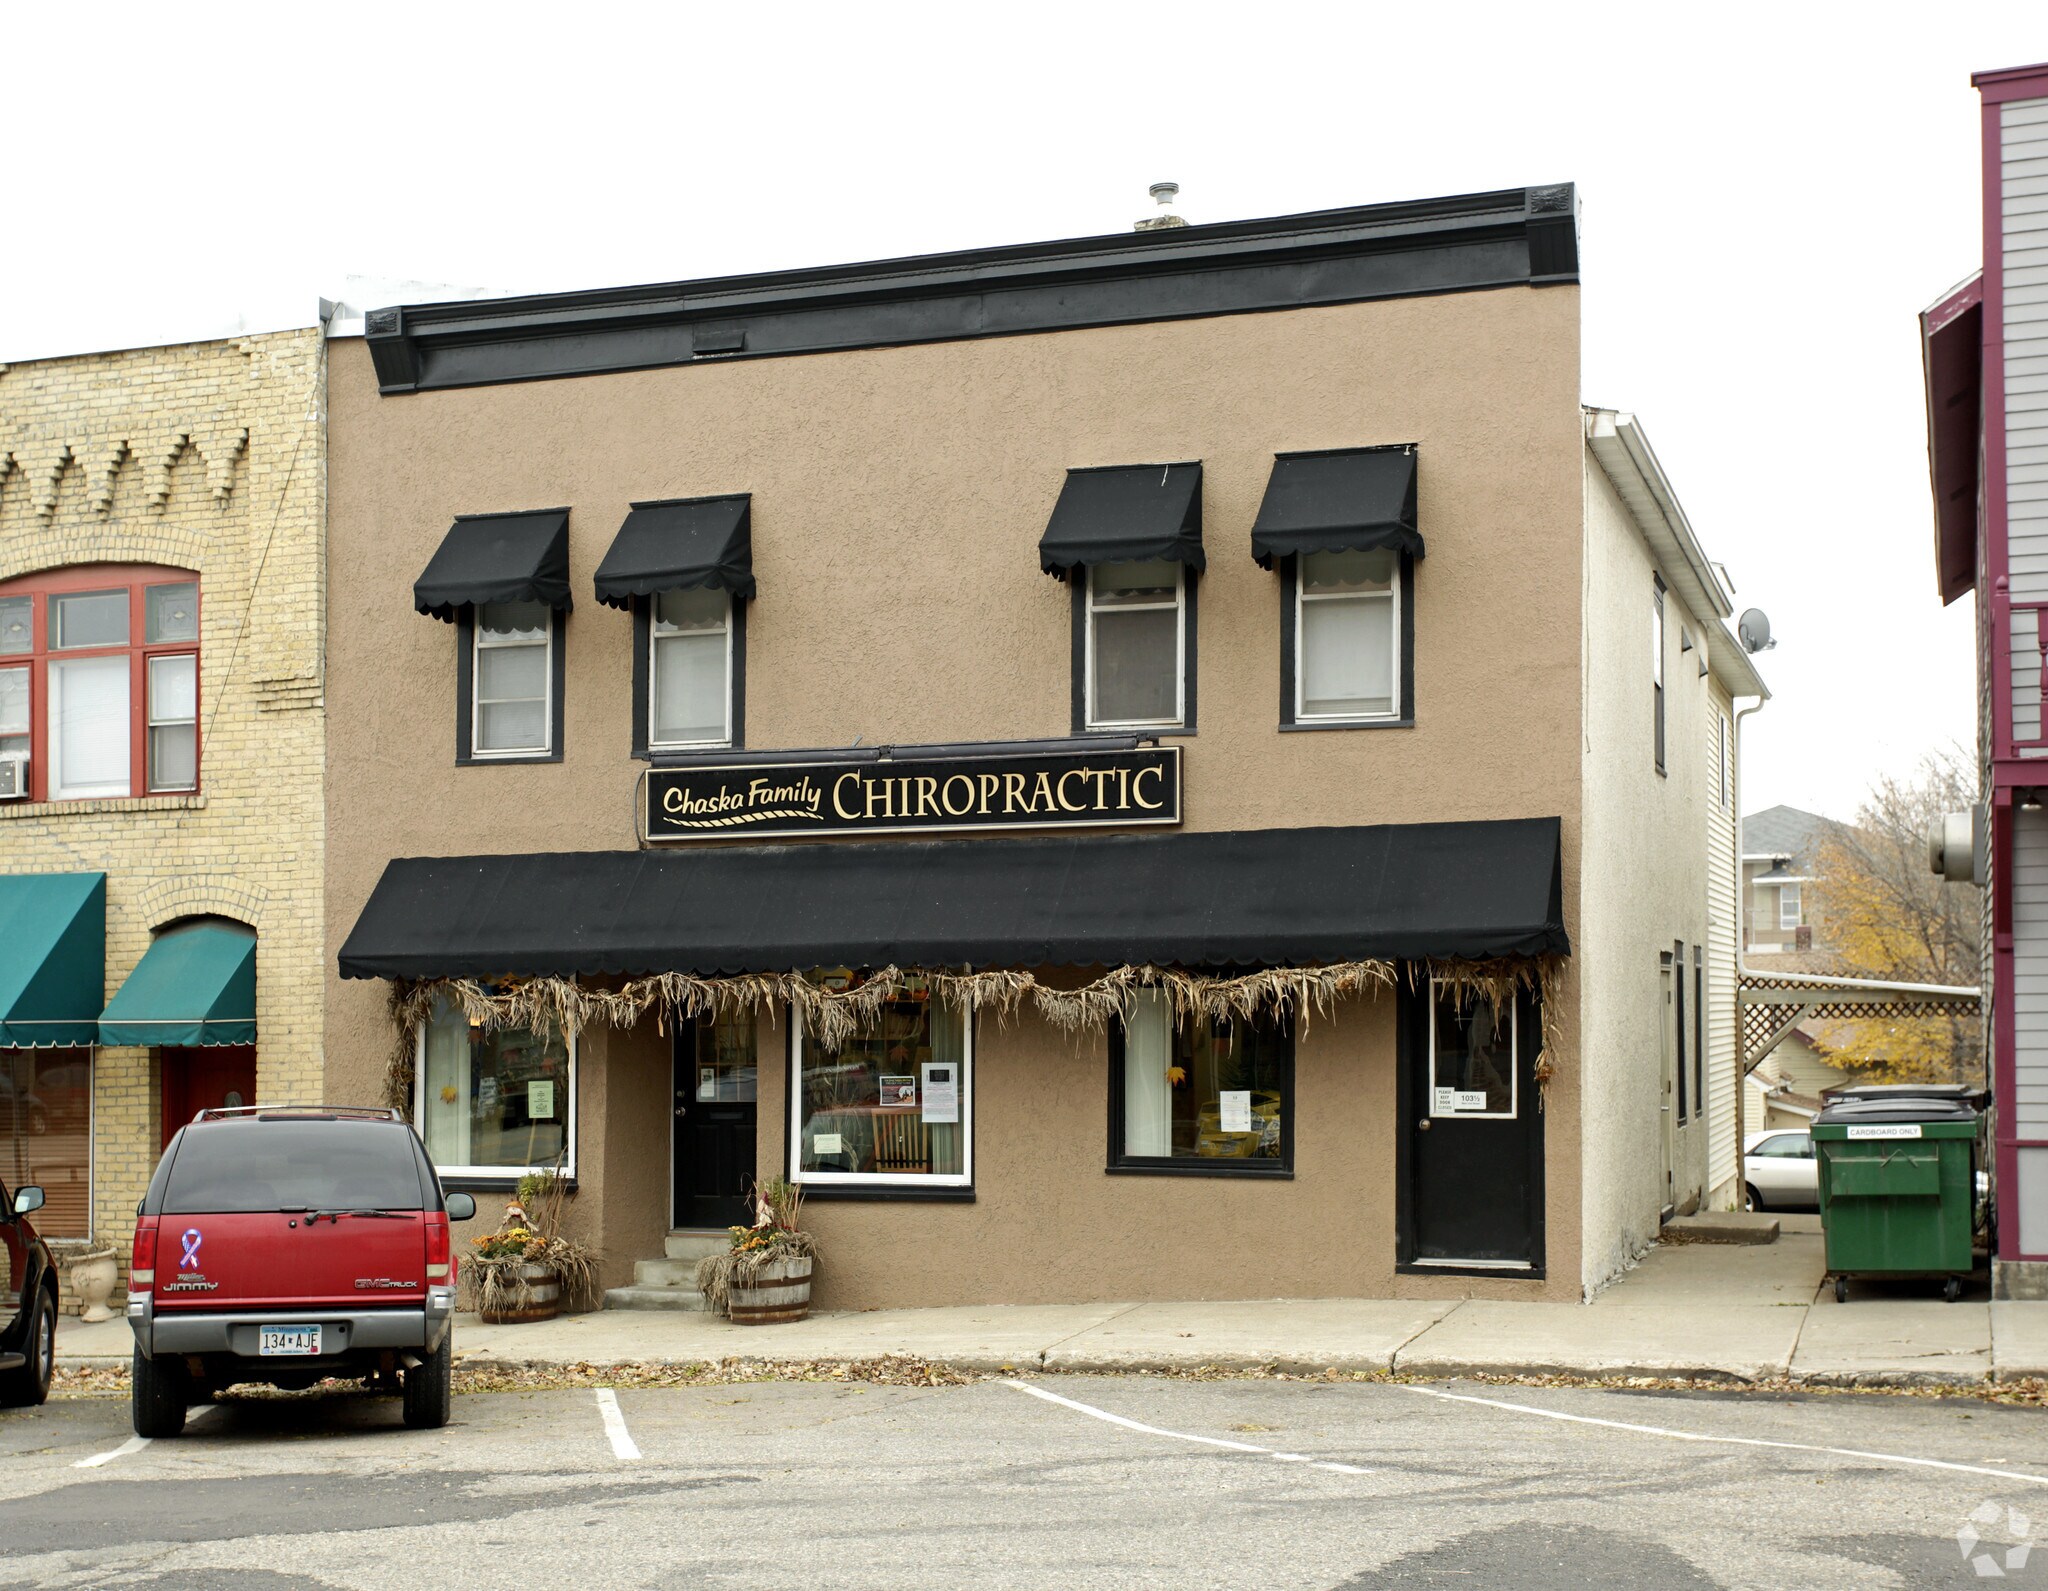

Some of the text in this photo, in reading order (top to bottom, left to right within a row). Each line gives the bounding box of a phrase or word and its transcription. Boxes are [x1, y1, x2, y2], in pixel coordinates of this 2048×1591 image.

[663, 763, 1164, 819] Chaska Family CHIROPRACTIC
[1850, 1127, 1919, 1136] CARDBOARD ONLY
[163, 1282, 219, 1291] JIMMY
[355, 1278, 390, 1289] GMC
[264, 1333, 318, 1349] 134 AJE
